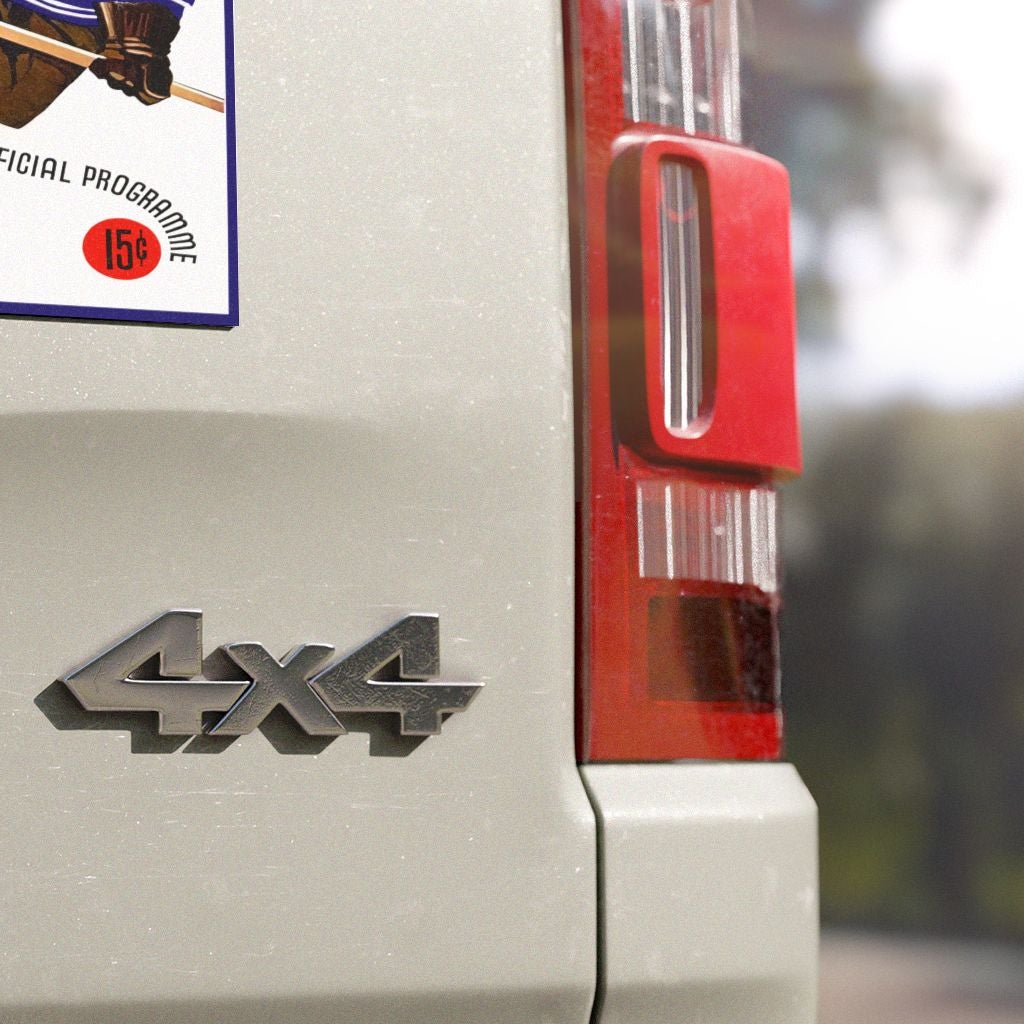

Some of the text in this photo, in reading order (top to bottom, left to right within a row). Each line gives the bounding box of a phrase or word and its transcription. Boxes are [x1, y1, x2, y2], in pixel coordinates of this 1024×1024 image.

[82, 165, 197, 264] PROGRAMME
[105, 228, 147, 270] 15¢
[63, 609, 485, 735] 4x4
